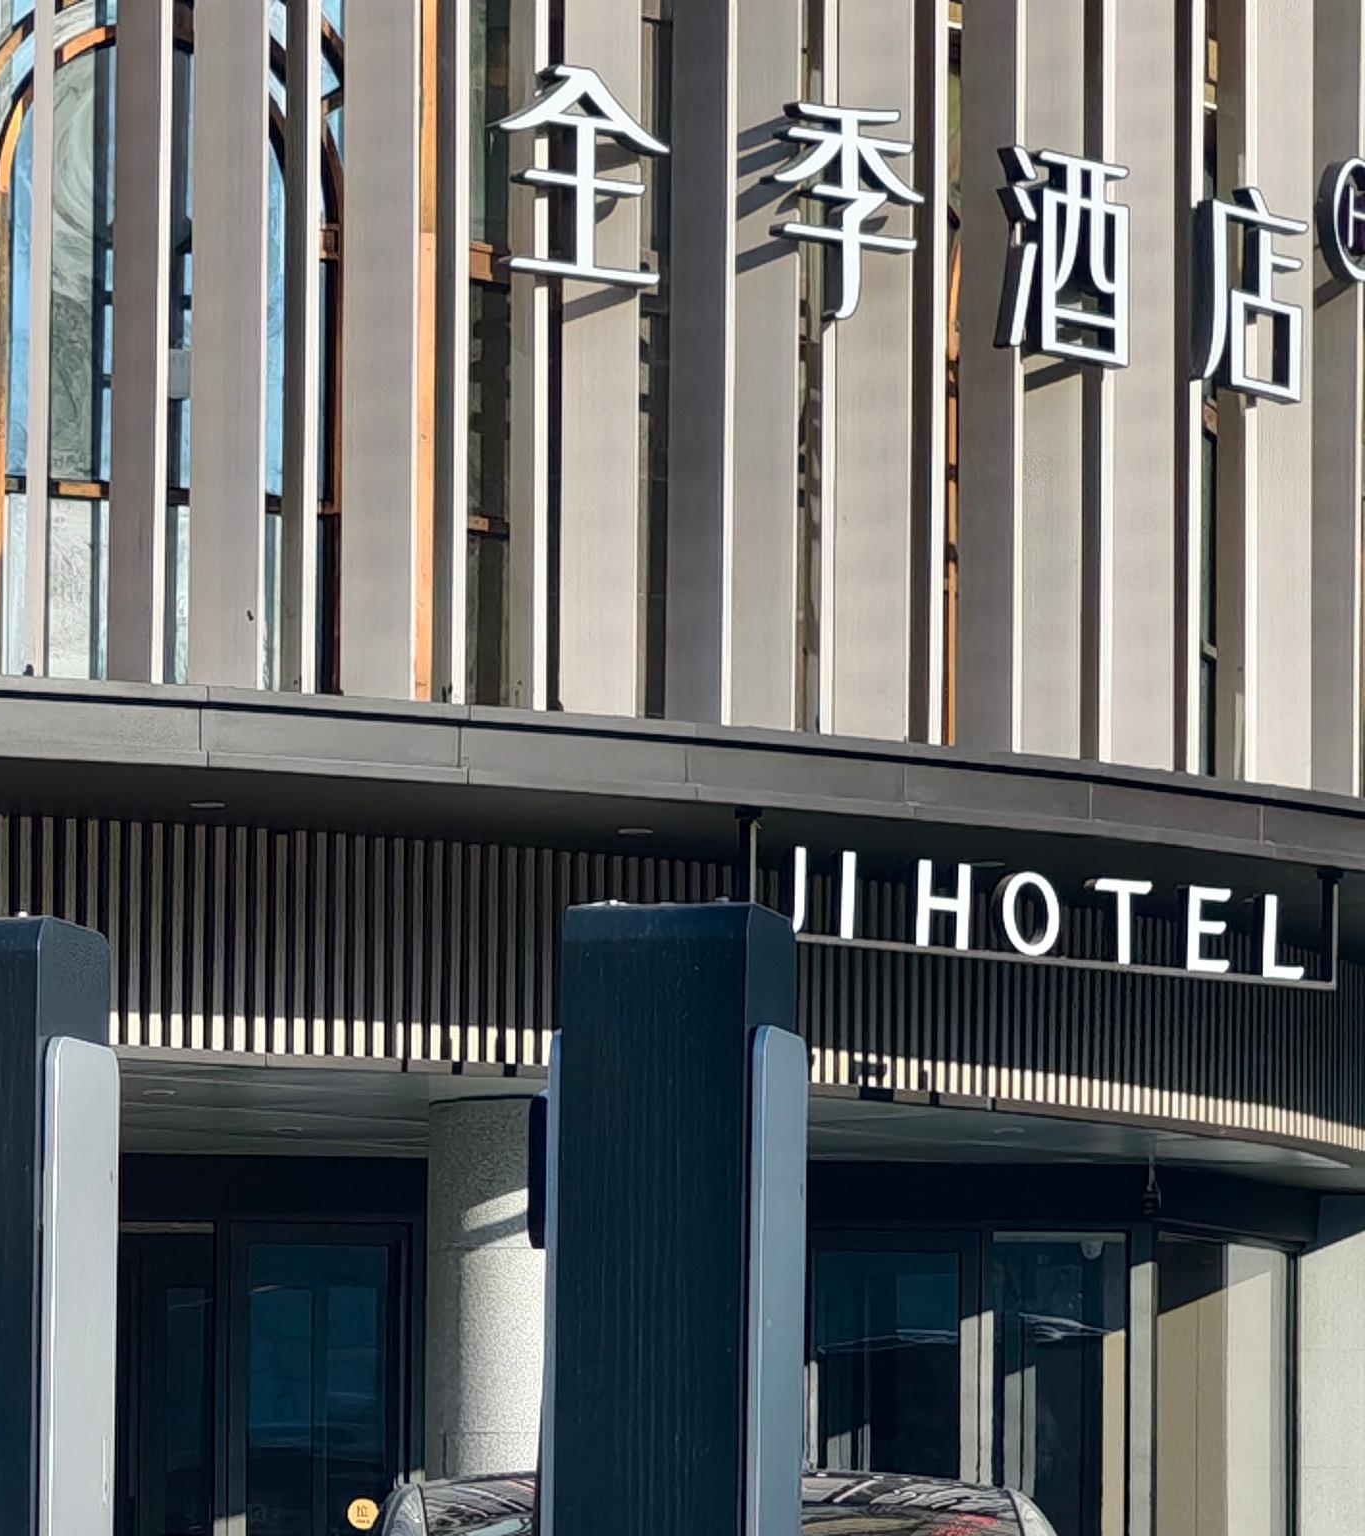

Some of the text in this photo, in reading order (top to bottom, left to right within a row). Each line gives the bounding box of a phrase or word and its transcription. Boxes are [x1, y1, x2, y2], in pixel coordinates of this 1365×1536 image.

[498, 64, 1308, 404] 全季酒店
[915, 859, 1305, 981] HOTEL
